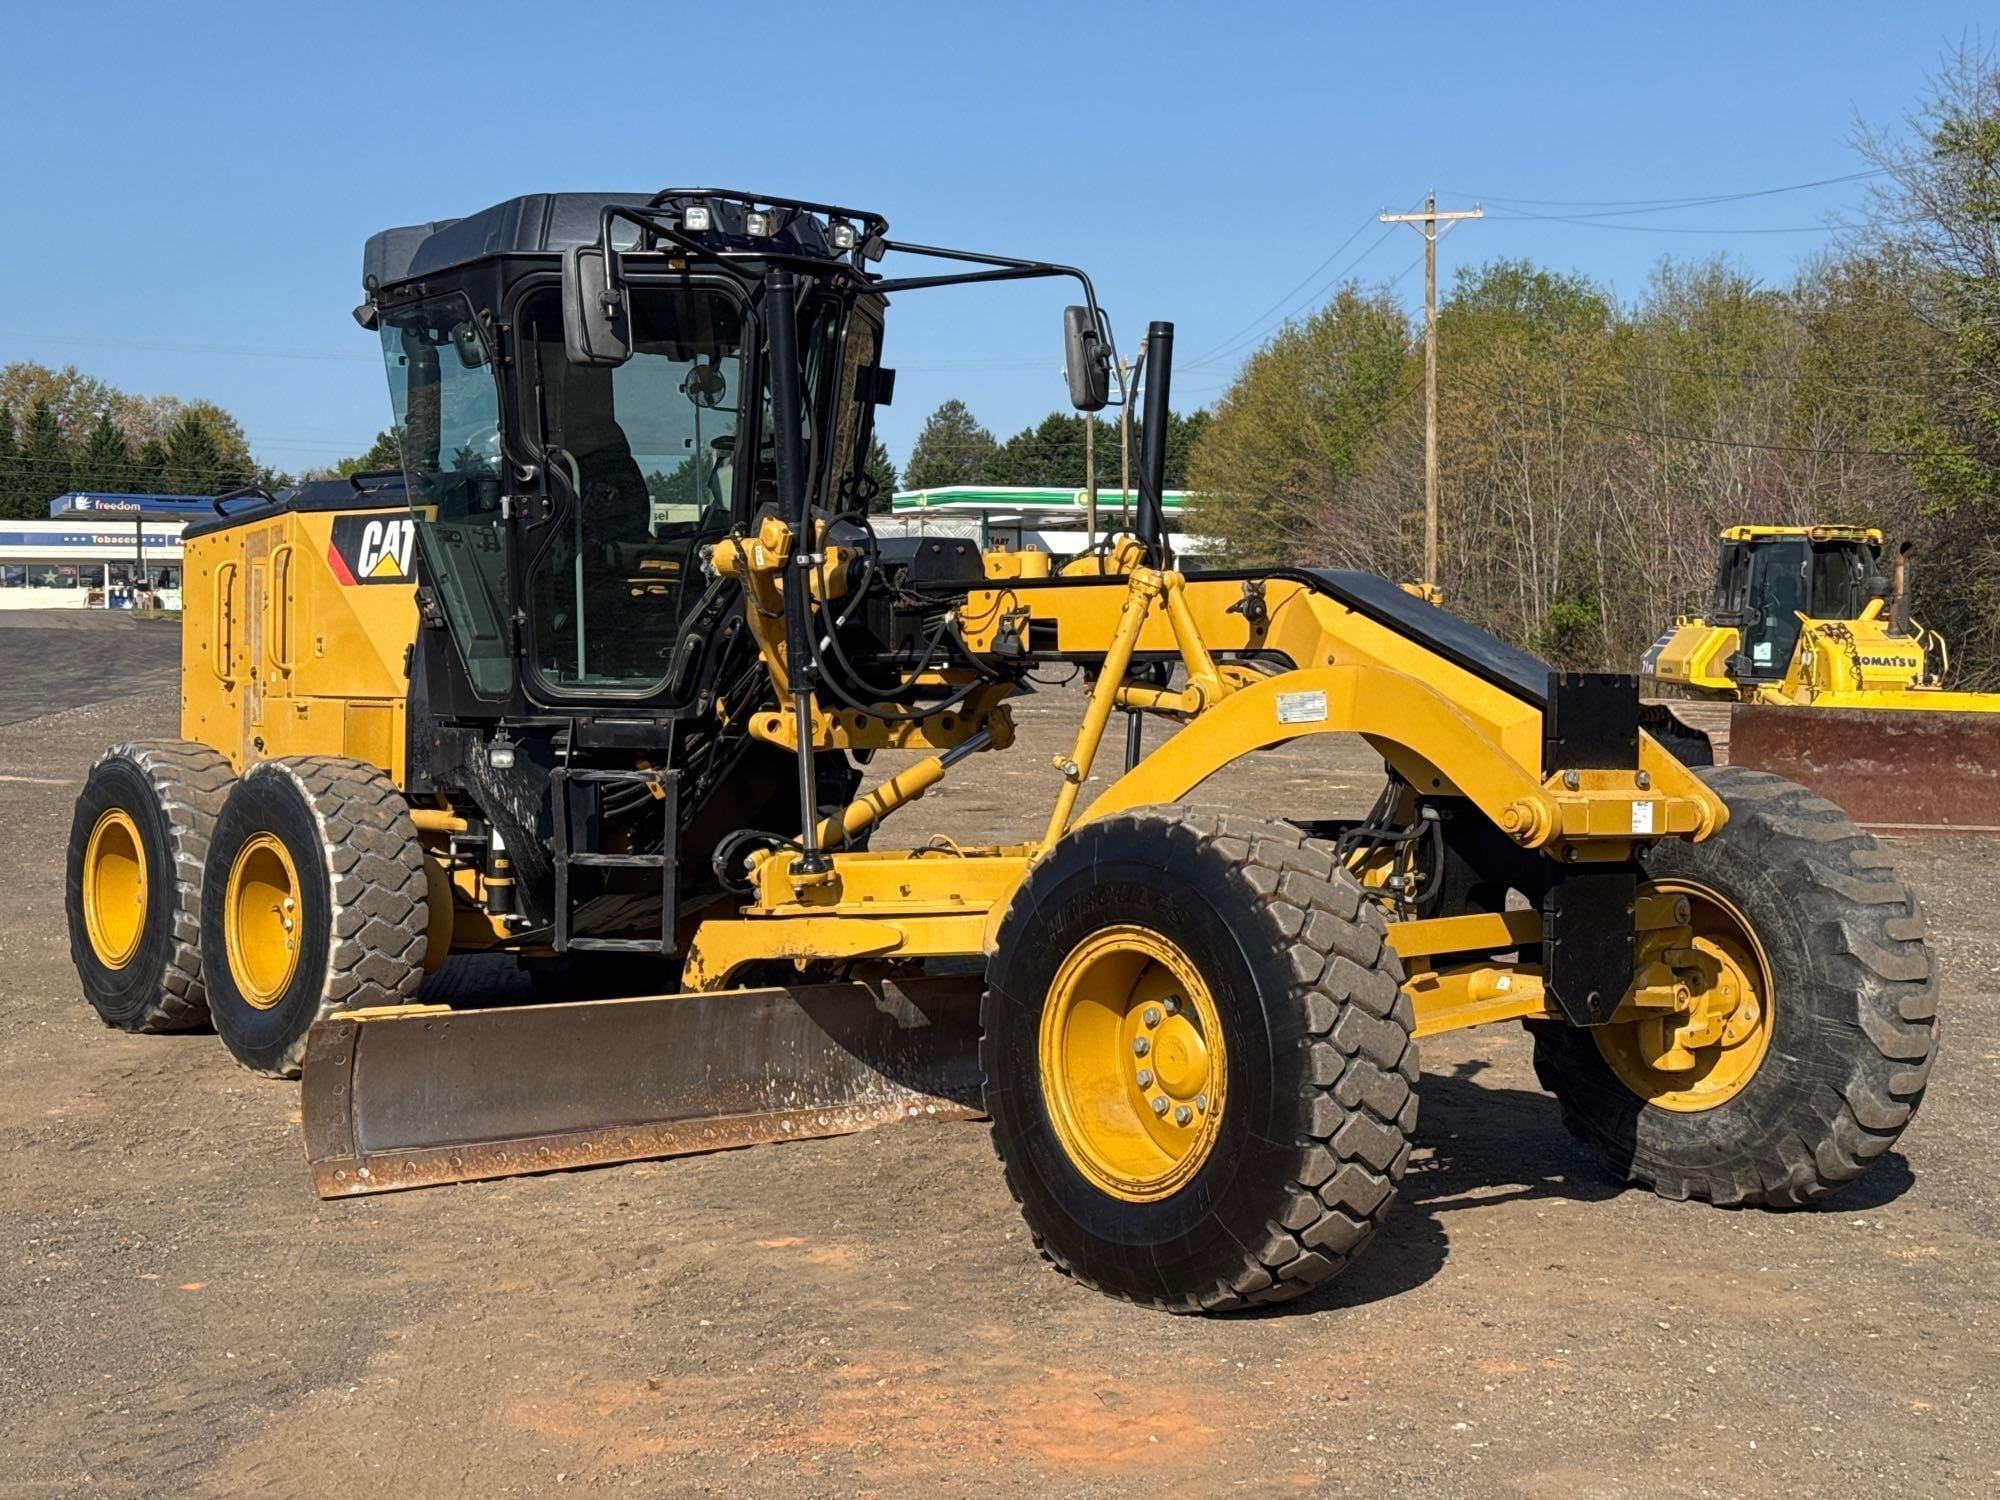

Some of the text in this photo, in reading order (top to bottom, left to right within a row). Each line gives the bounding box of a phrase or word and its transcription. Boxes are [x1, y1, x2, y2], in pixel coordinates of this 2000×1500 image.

[95, 500, 140, 512] freedom
[91, 535, 137, 544] Tobacco
[358, 520, 415, 577] CAT
[1852, 655, 1916, 667] KOMATSU
